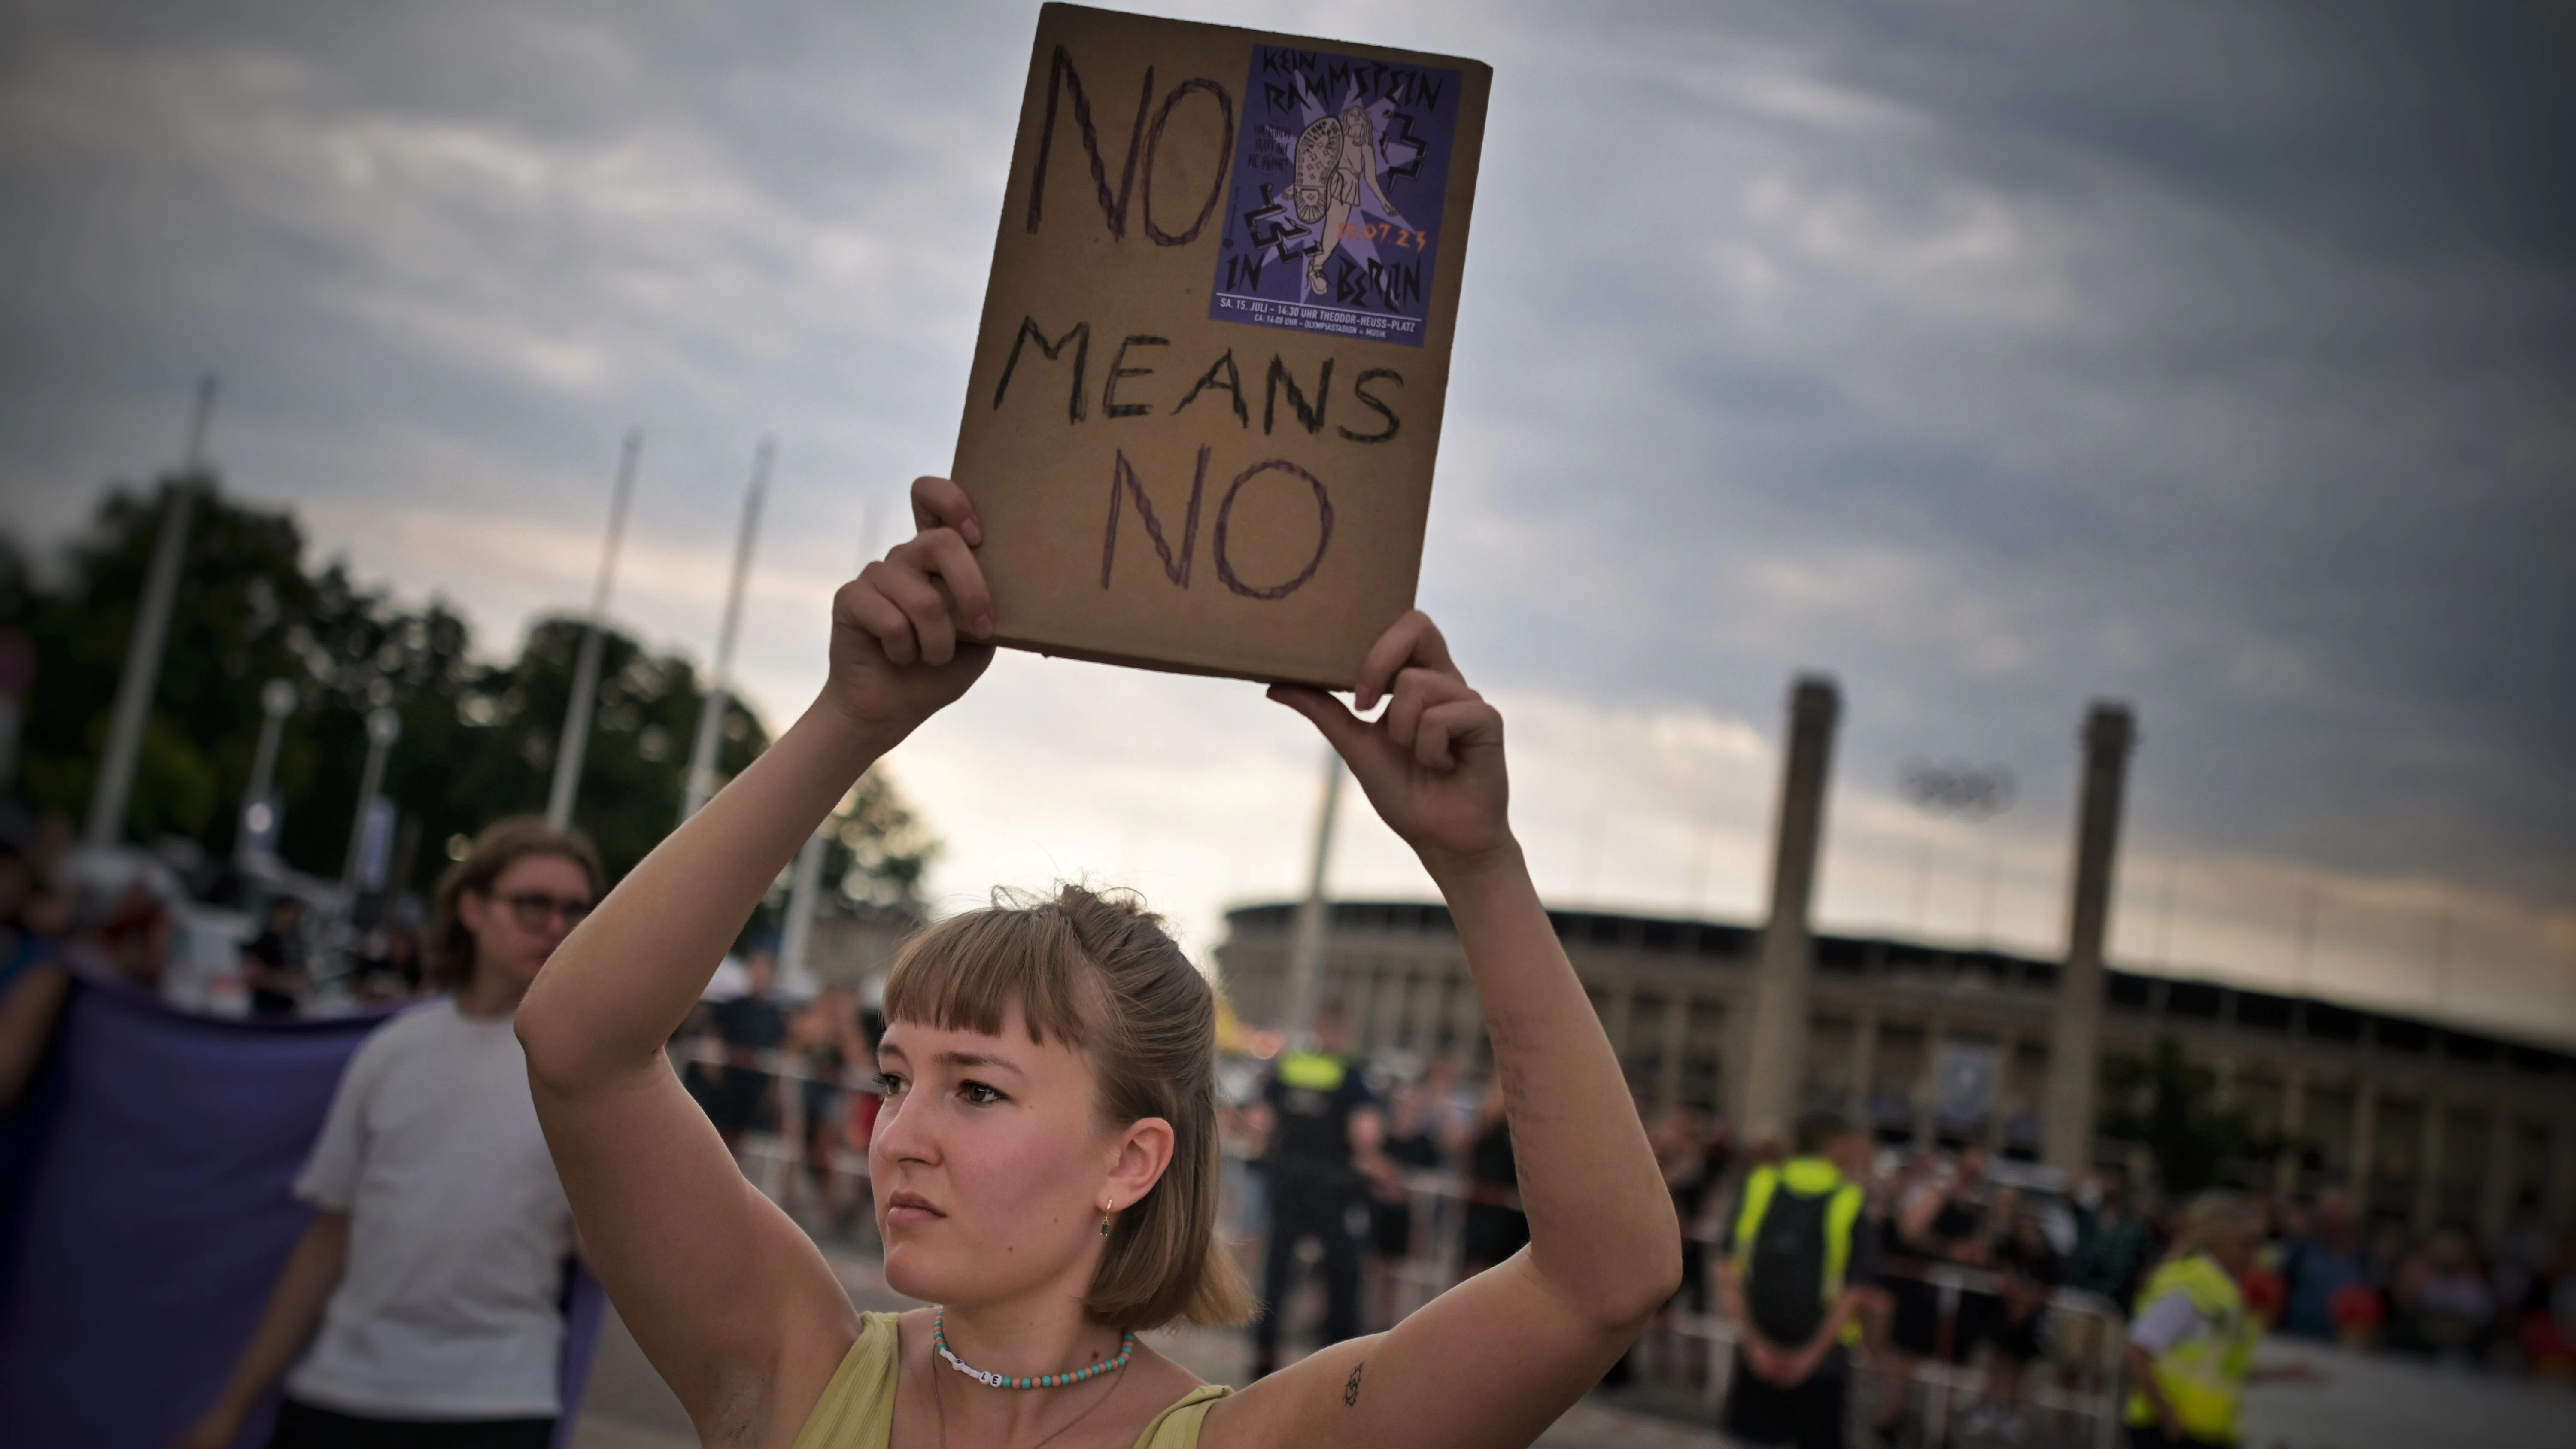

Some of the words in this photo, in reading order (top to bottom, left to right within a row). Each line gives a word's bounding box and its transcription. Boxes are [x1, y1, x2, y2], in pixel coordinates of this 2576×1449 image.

[1263, 47, 1316, 78] KEIN
[1264, 61, 1443, 114] RAMMSTEIN
[1027, 44, 1233, 247] NO
[1227, 254, 1264, 293] IN
[1336, 255, 1420, 314] BERLIN
[1220, 298, 1233, 309] SA.
[1236, 300, 1247, 310] 15.
[1250, 302, 1268, 313] JULI
[1301, 308, 1318, 320] UHR
[1320, 310, 1416, 332] THEODOR-HEUSS-PLATZ
[1254, 314, 1264, 322] CA.
[1285, 318, 1298, 326] UHR
[1305, 321, 1357, 334] OLYMPIASTADION
[1365, 328, 1387, 338] MUSIK
[993, 316, 1404, 443] MEANS
[1101, 443, 1334, 600] NO
